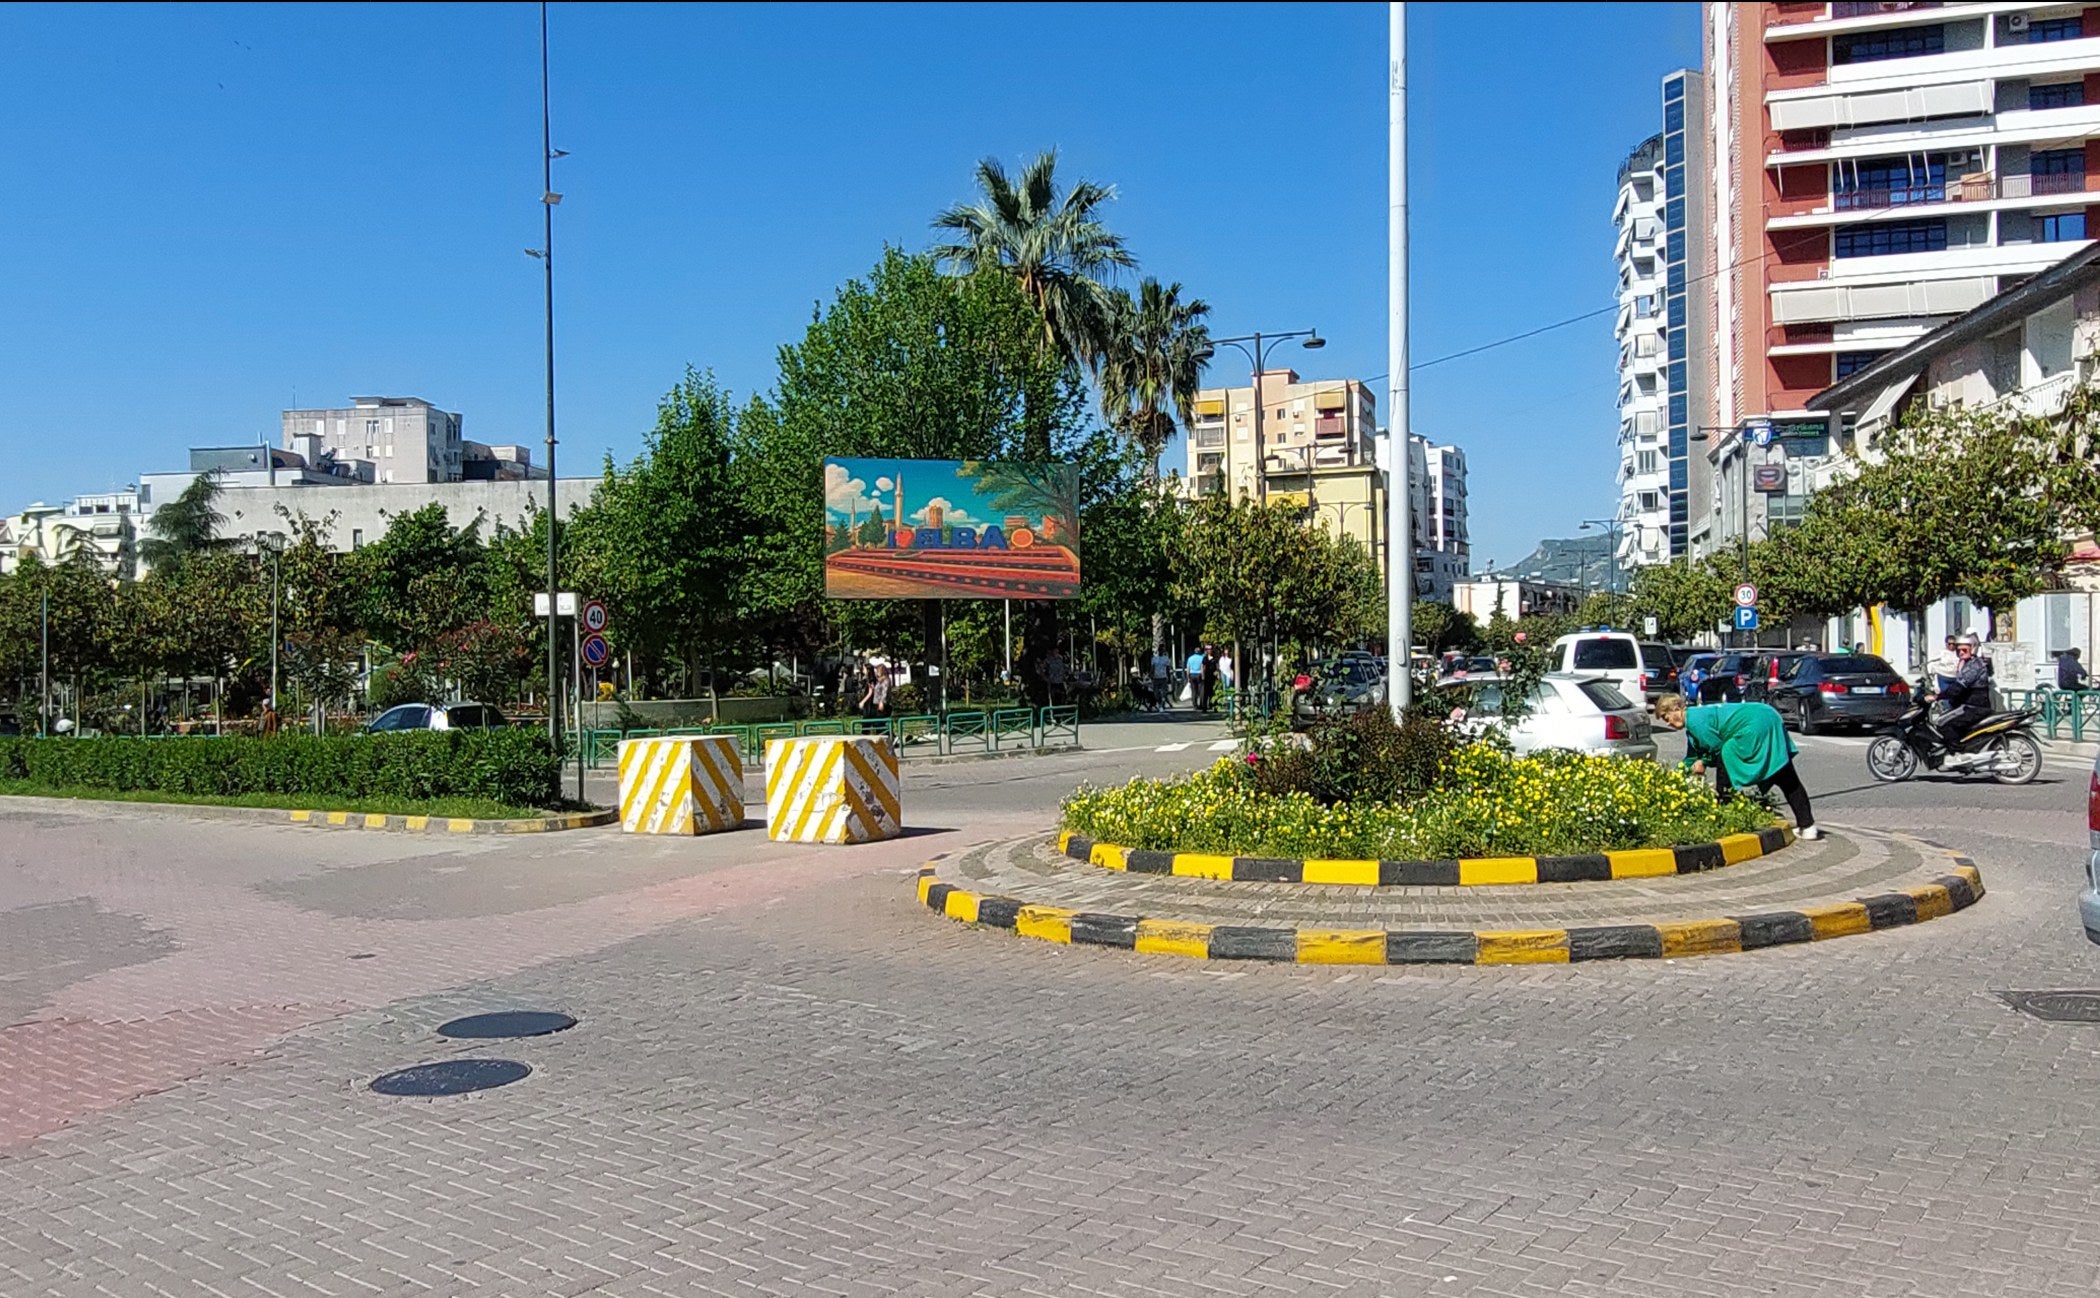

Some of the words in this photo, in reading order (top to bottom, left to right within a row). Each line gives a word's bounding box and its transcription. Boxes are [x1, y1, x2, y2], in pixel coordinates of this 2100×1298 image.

[1740, 590, 1752, 600] 30
[589, 610, 603, 624] 40
[1740, 609, 1753, 626] P
